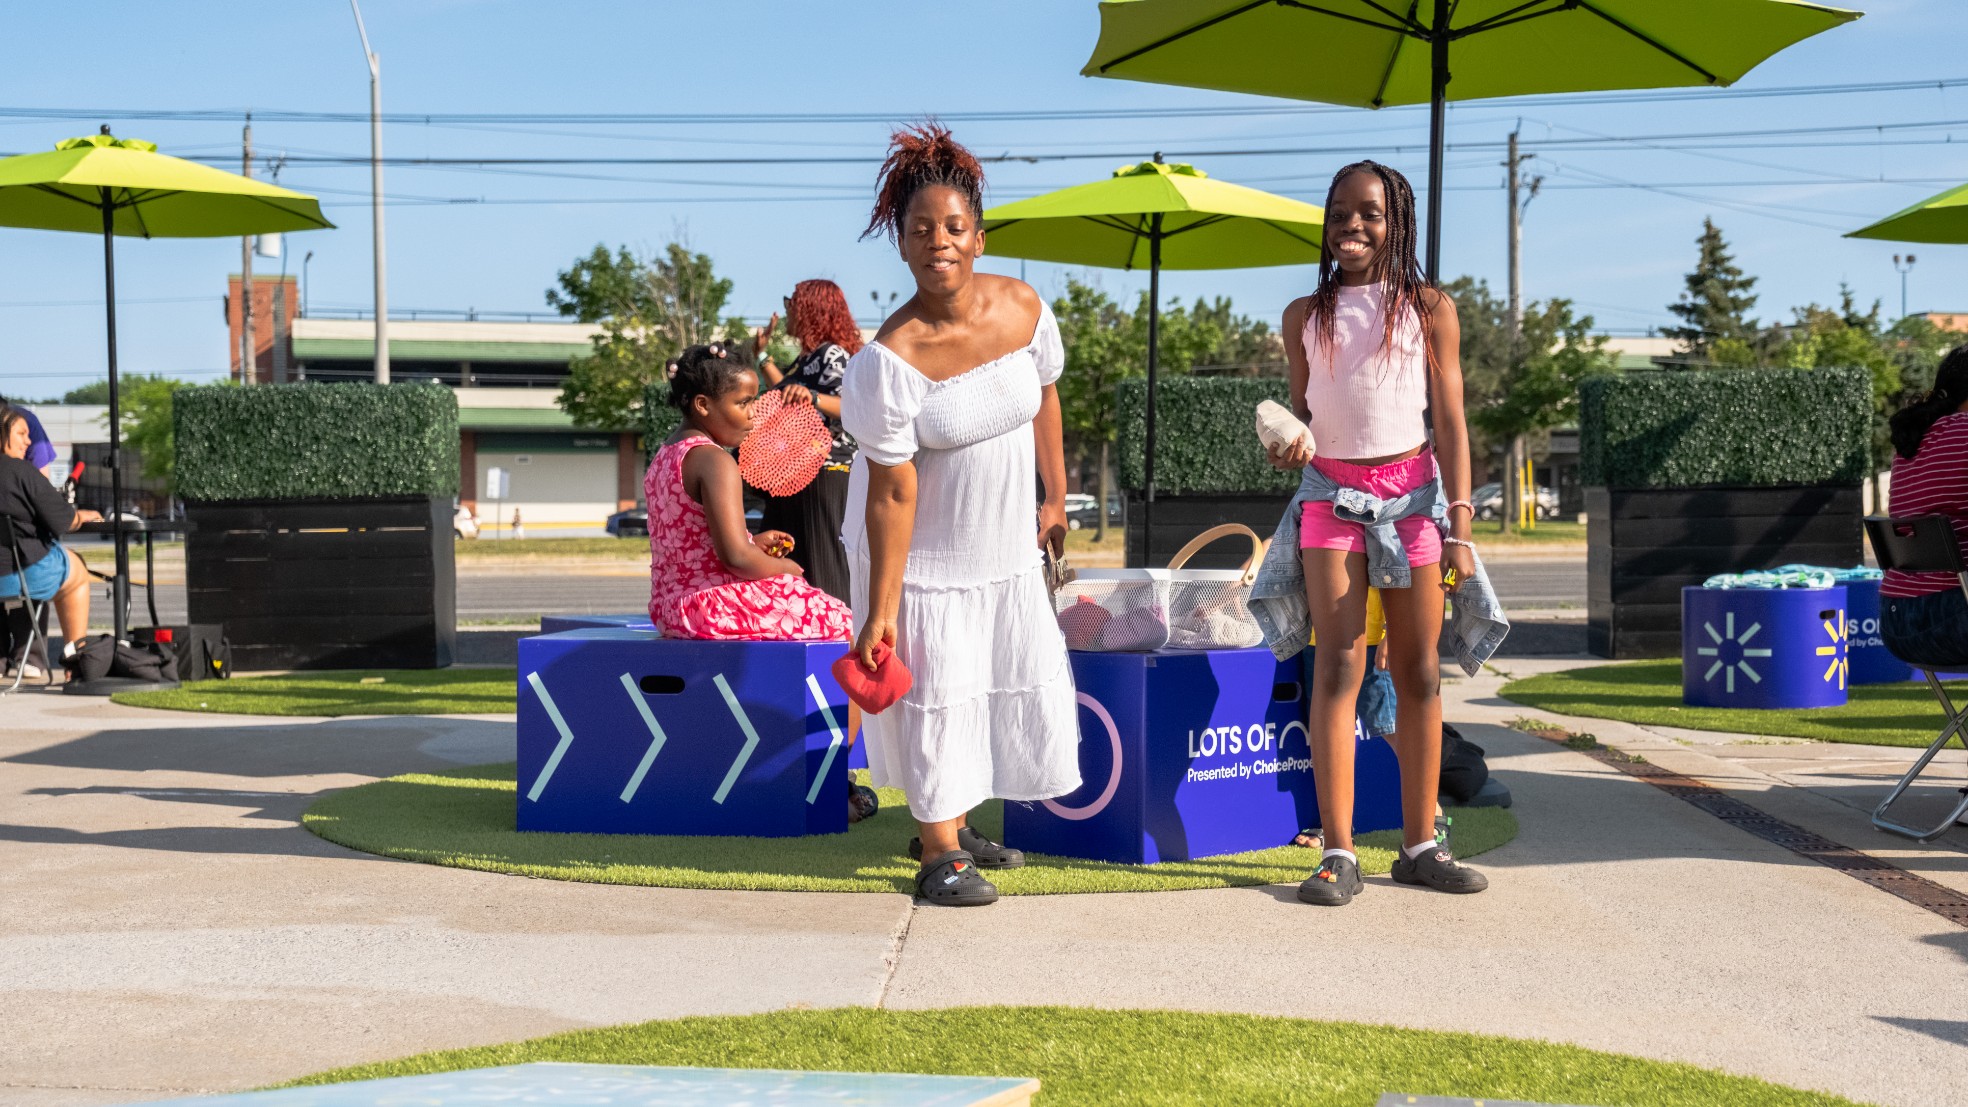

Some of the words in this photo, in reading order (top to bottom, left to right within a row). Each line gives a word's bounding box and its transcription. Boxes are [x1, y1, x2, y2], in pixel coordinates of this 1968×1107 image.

[1188, 725, 1242, 758] LOTS
[1246, 722, 1276, 752] OF
[1187, 763, 1237, 782] Presented
[1239, 759, 1252, 779] by
[1253, 757, 1314, 775] ChoicePrope
